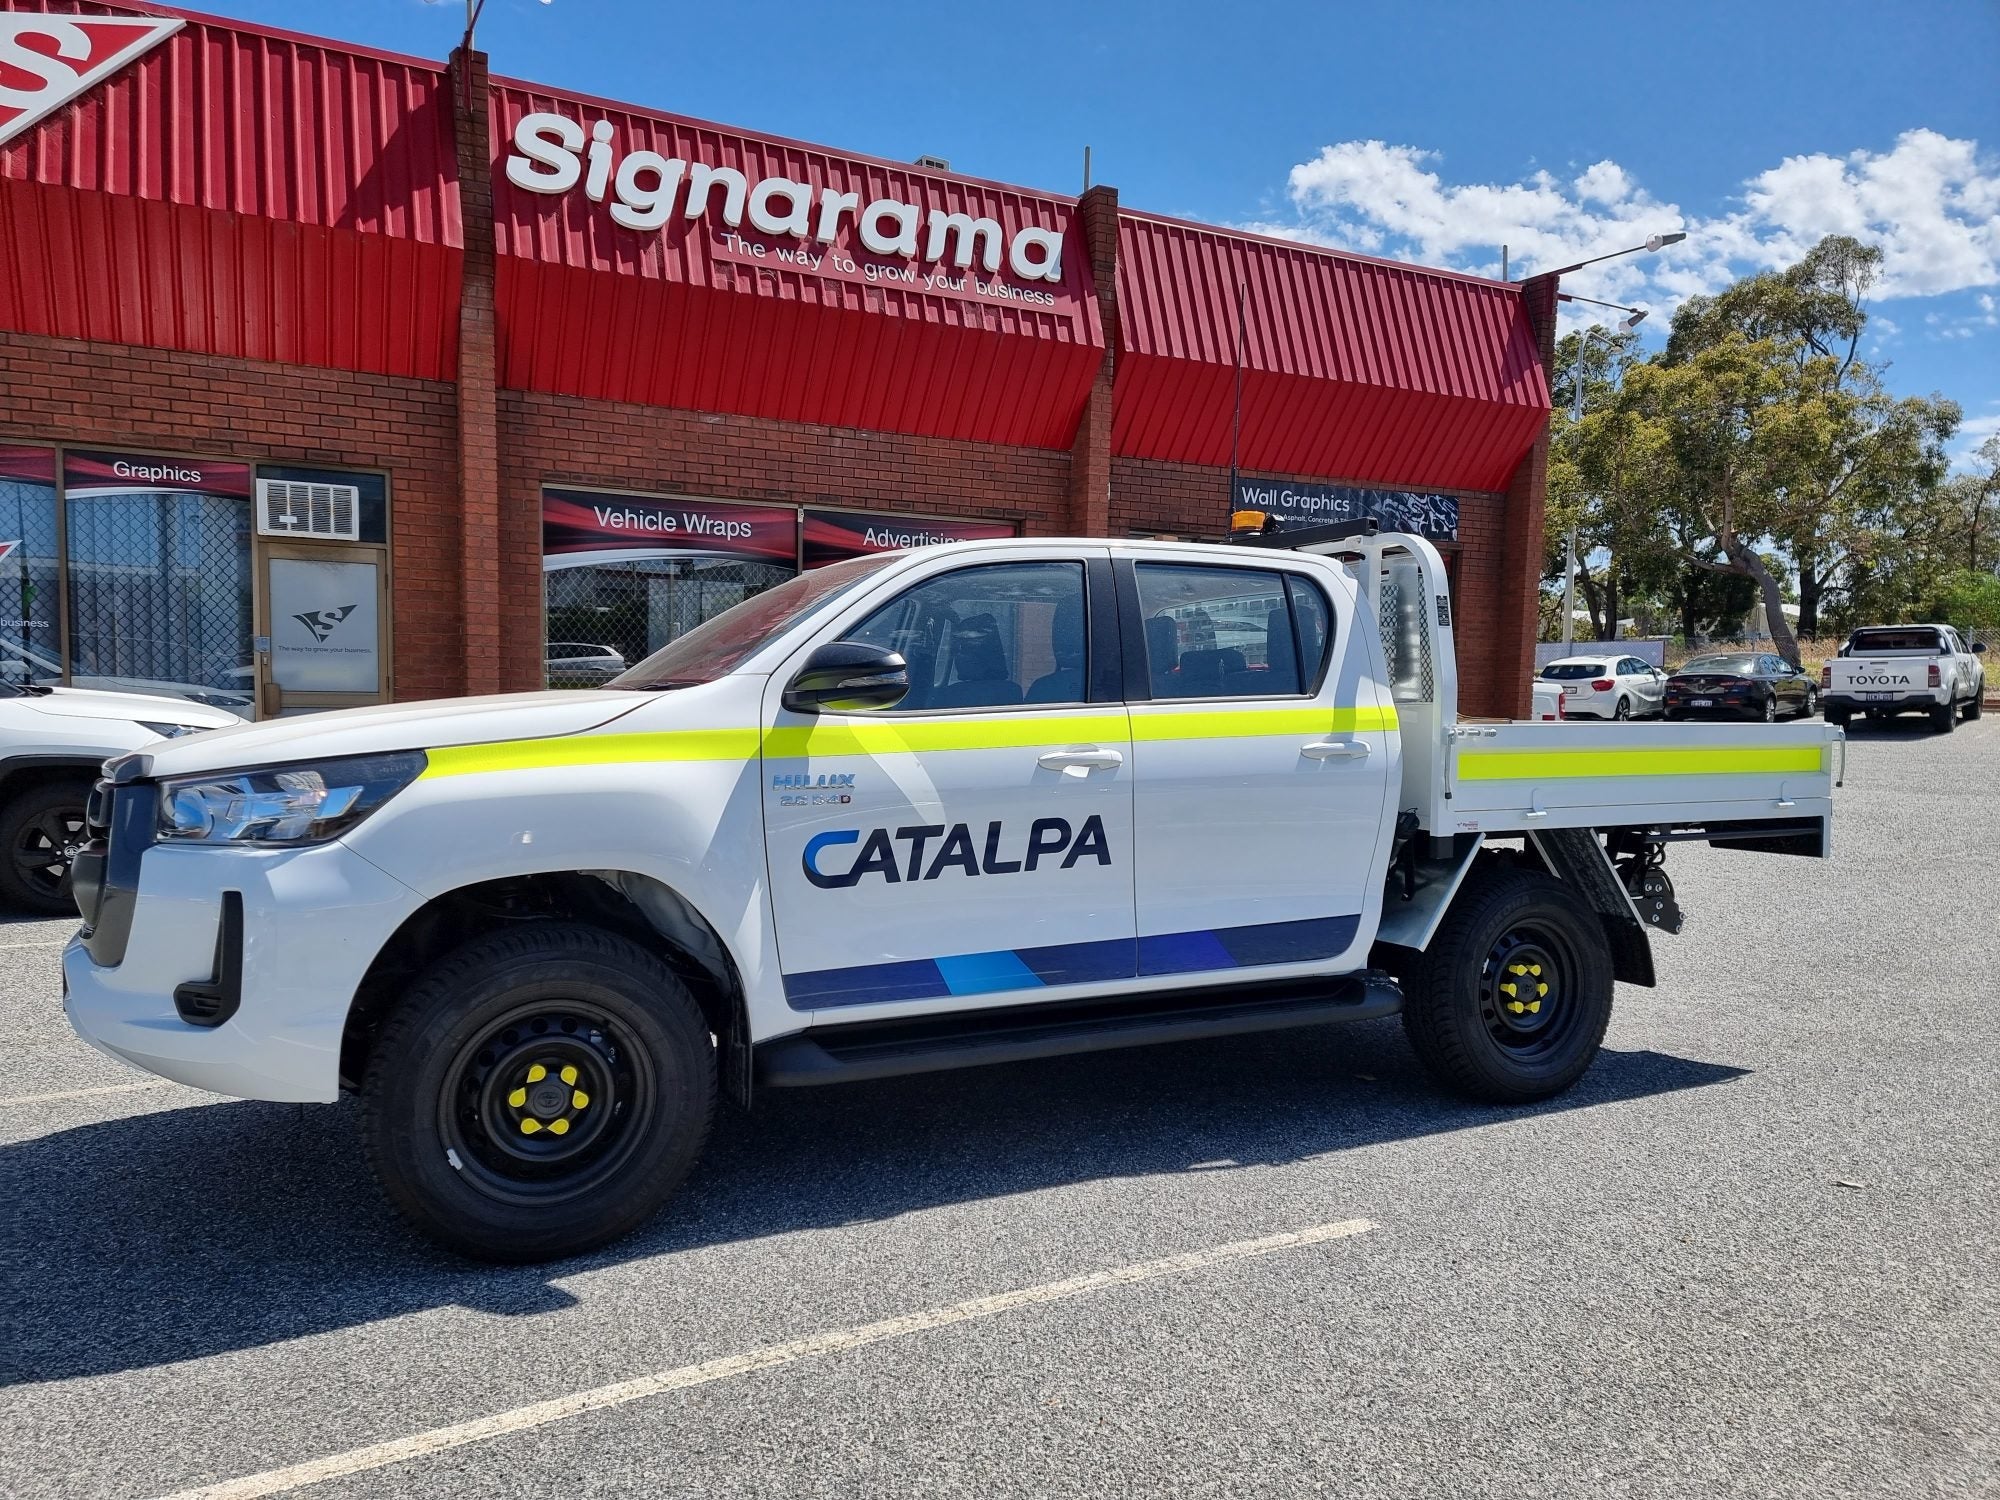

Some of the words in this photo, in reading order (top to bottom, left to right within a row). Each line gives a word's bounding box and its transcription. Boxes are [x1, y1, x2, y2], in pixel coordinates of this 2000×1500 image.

[506, 113, 1064, 282] Signarama
[721, 232, 766, 258] The
[776, 247, 822, 271] way
[832, 254, 856, 273] to
[864, 263, 915, 283] grow
[923, 272, 967, 291] your
[975, 277, 1055, 306] business
[113, 461, 202, 482] Graphics
[1242, 486, 1277, 506] Wall
[1280, 490, 1350, 513] Graphics
[594, 505, 677, 532] Vehicle
[683, 512, 752, 540] Wraps
[863, 527, 967, 548] Advertisi
[0, 617, 49, 628] business
[1846, 675, 1911, 685] TOYOTA
[772, 773, 856, 791] HILUX
[802, 815, 1112, 889] CATALPA
